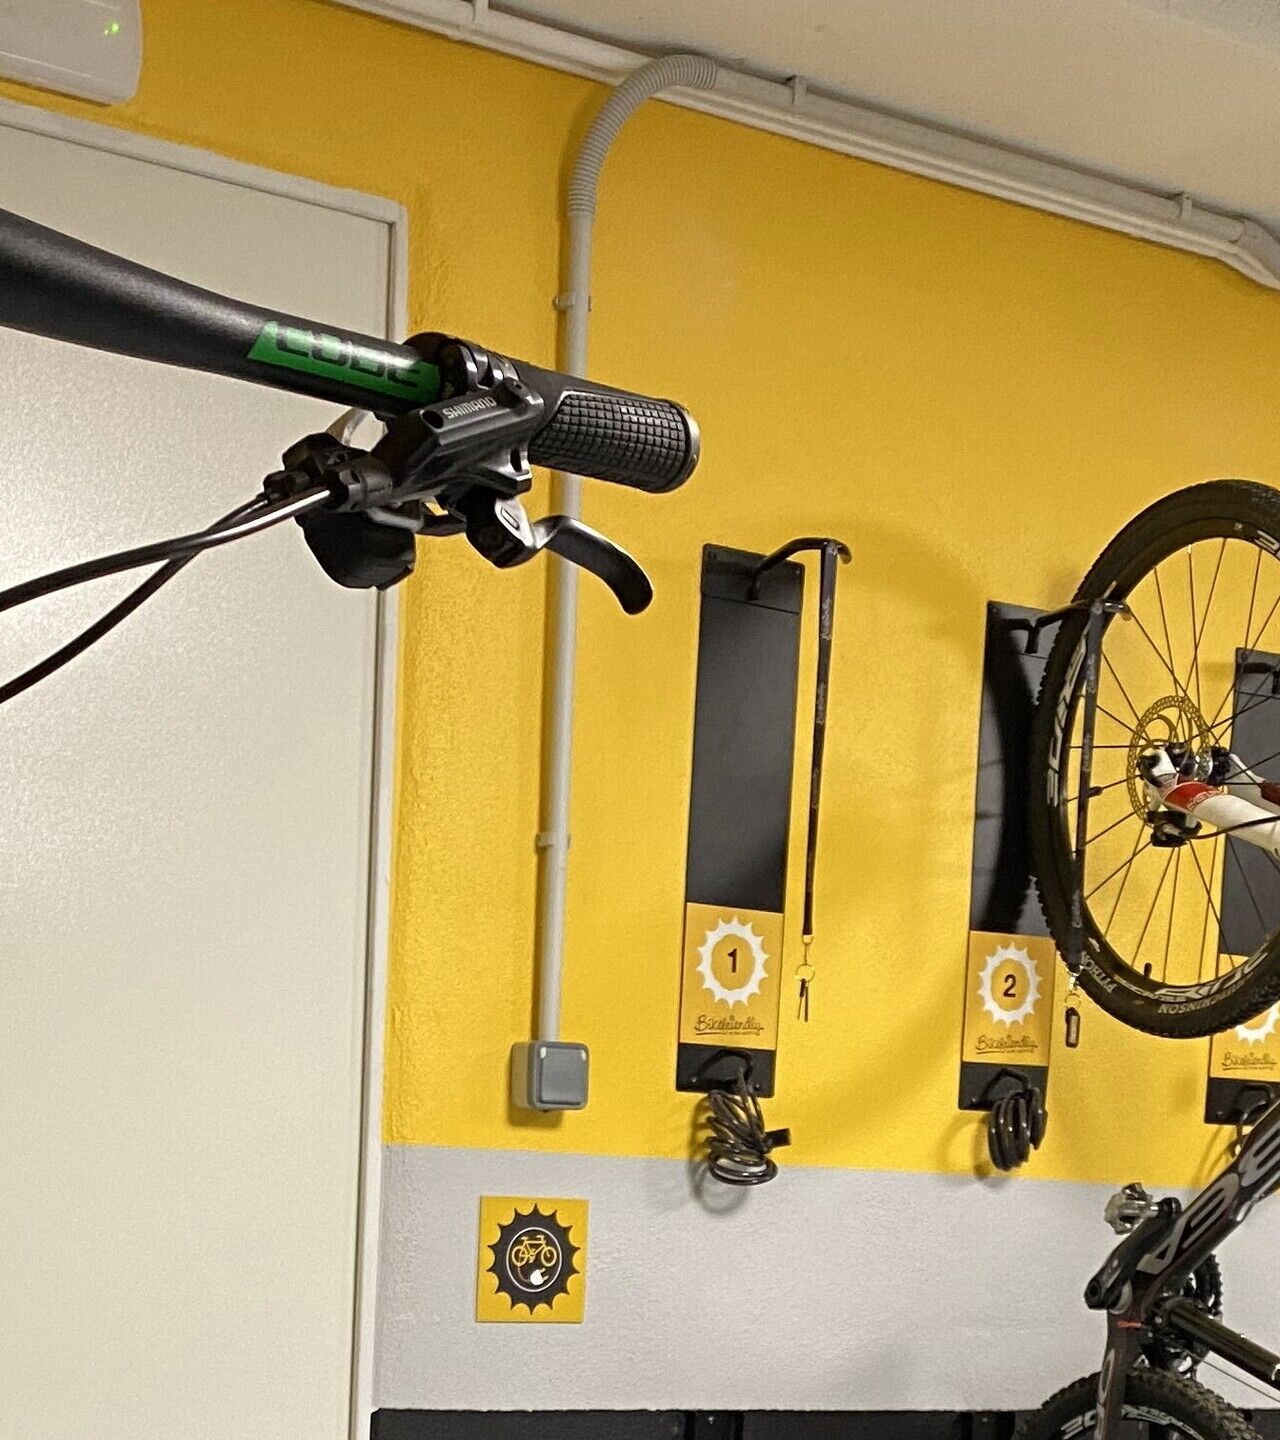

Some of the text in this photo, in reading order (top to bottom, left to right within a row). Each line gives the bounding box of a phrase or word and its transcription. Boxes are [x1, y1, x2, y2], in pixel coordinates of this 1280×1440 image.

[442, 396, 498, 420] SHIMANO
[727, 948, 738, 973] 1
[1003, 974, 1016, 997] 2
